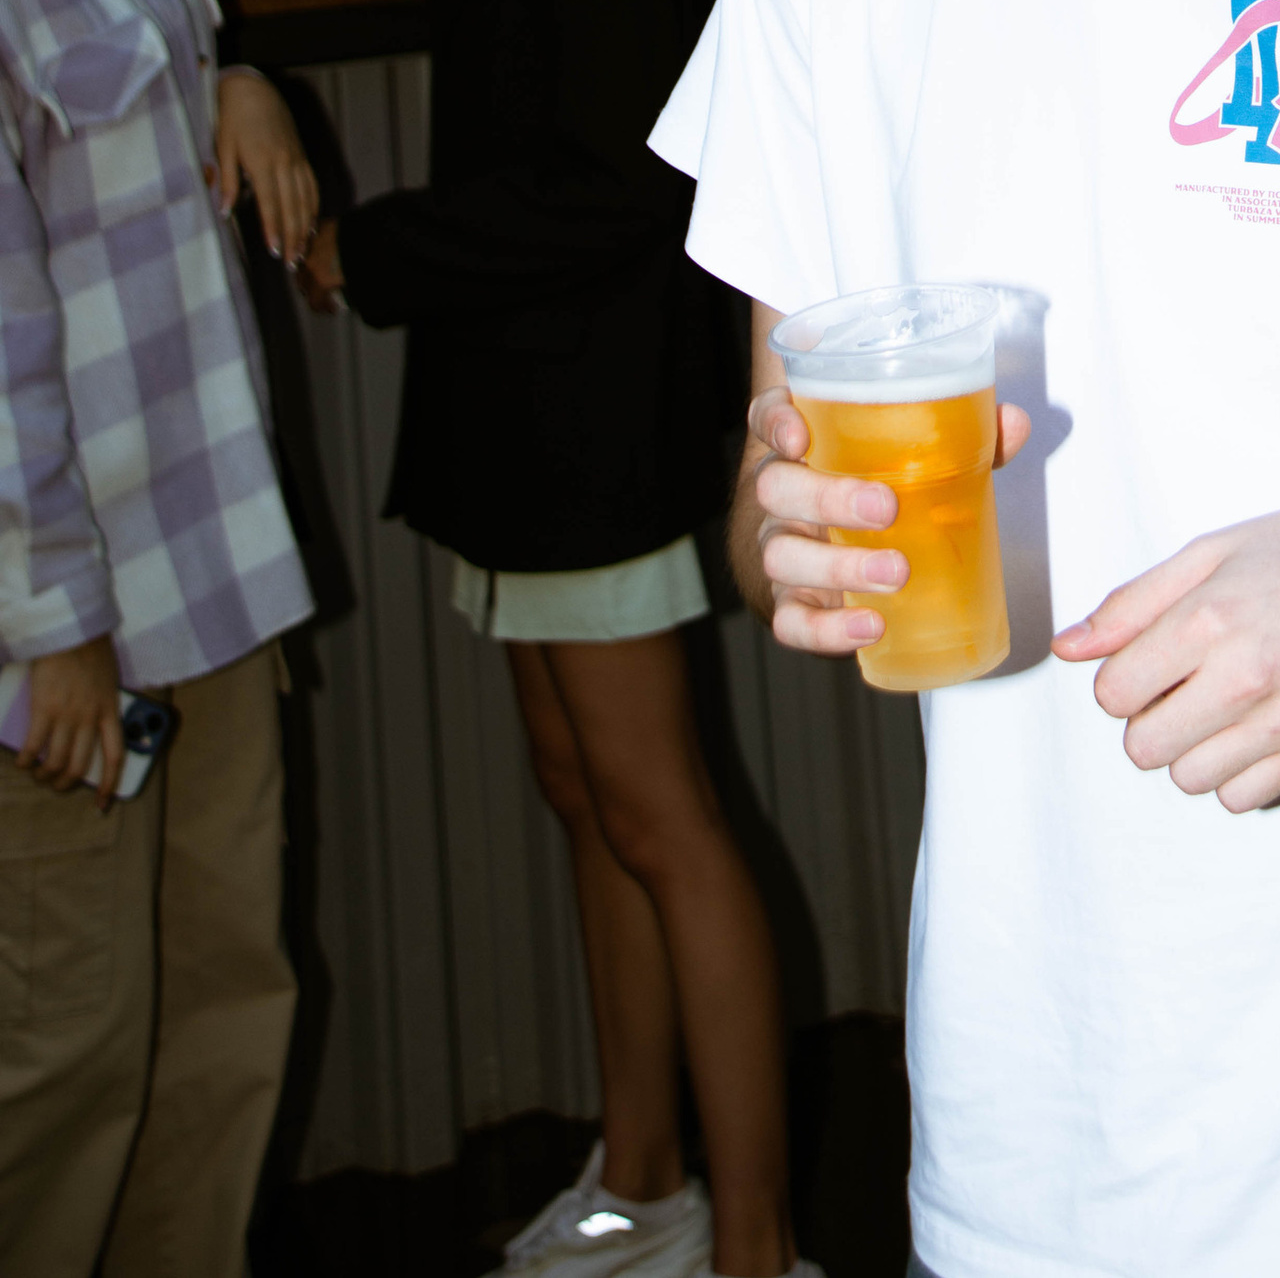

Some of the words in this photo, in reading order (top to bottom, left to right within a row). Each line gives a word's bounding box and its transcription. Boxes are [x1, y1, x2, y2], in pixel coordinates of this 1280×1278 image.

[1175, 183, 1250, 197] MANUFACTURED
[1252, 189, 1265, 198] BY
[1222, 195, 1232, 203] IN
[1228, 203, 1273, 216] TURBAZA
[1233, 213, 1244, 222] IN
